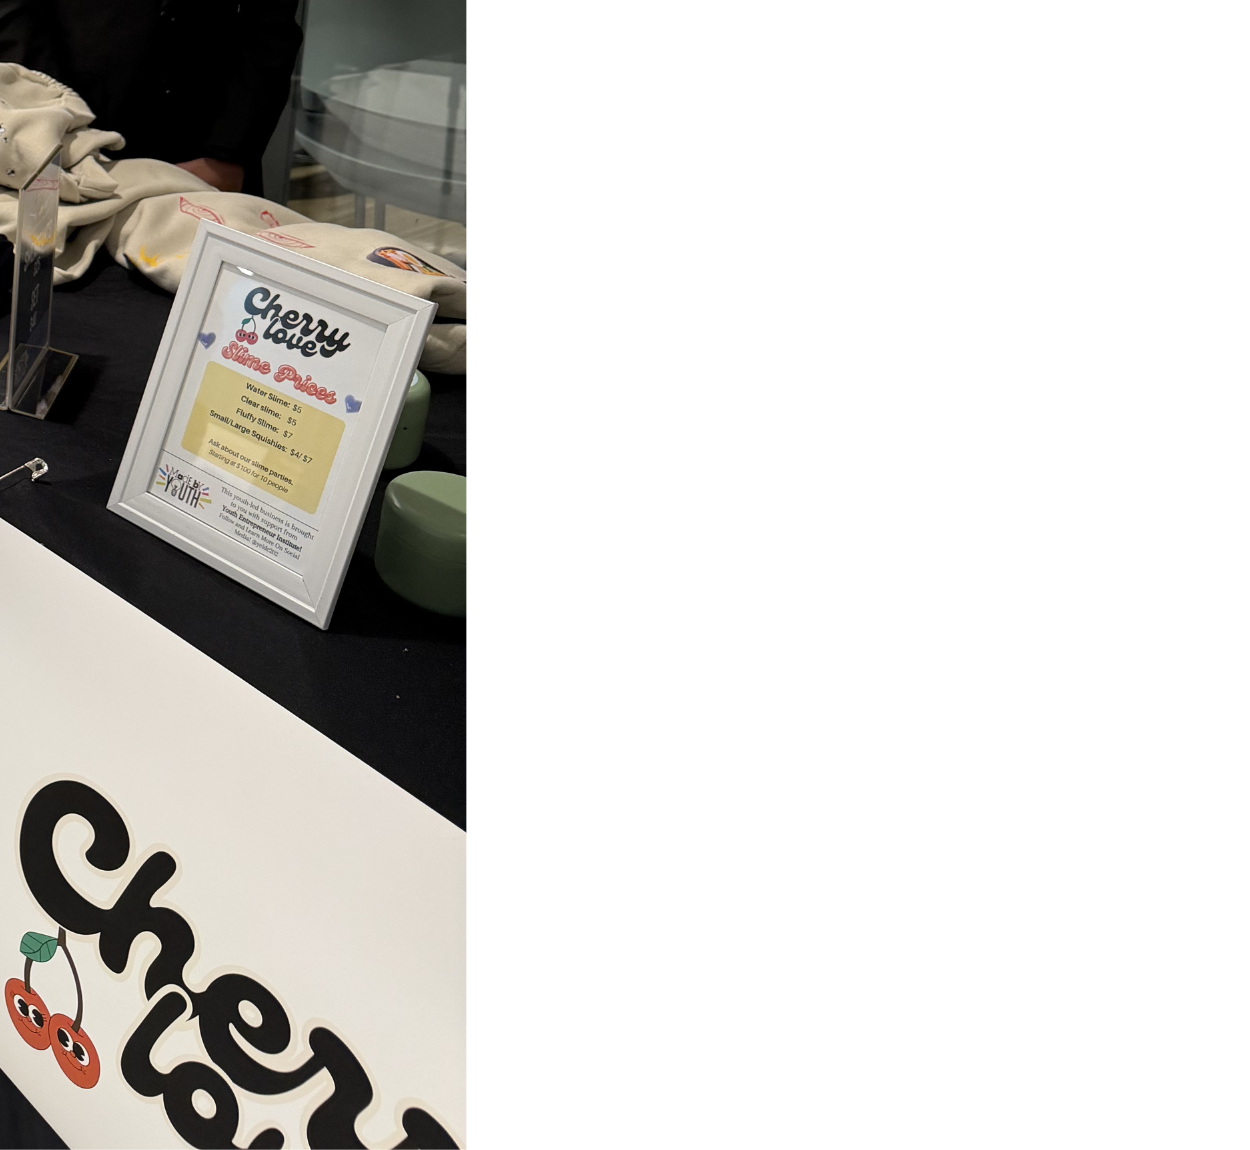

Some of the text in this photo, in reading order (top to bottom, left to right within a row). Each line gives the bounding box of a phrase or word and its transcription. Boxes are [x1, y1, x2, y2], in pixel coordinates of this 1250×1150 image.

[244, 286, 351, 358] Cherry
[262, 317, 318, 357] love
[221, 341, 337, 405] Slime Prices
[240, 395, 297, 426] Clear slime: $5
[246, 382, 302, 414] Water Slime: $5
[209, 409, 251, 435] Small/Large
[251, 431, 288, 453] Squishies:
[302, 454, 313, 464] $7
[236, 407, 293, 439] Fluffy Slime: $7
[208, 438, 294, 486] Ask about our slime parties.
[208, 449, 230, 465] Starting
[230, 460, 236, 468] at
[251, 470, 260, 479] for
[260, 475, 268, 483] 10
[267, 479, 289, 494] people
[164, 473, 202, 509] YOUTH
[221, 486, 315, 540] This youth-led business is brought
[218, 512, 301, 560] Follow and Learn More On Social
[222, 504, 238, 518] Youth
[238, 513, 277, 538] Entrepreneur
[230, 501, 298, 541] to you with support from
[19, 779, 462, 1149] Cher
[120, 990, 285, 1149] lo
